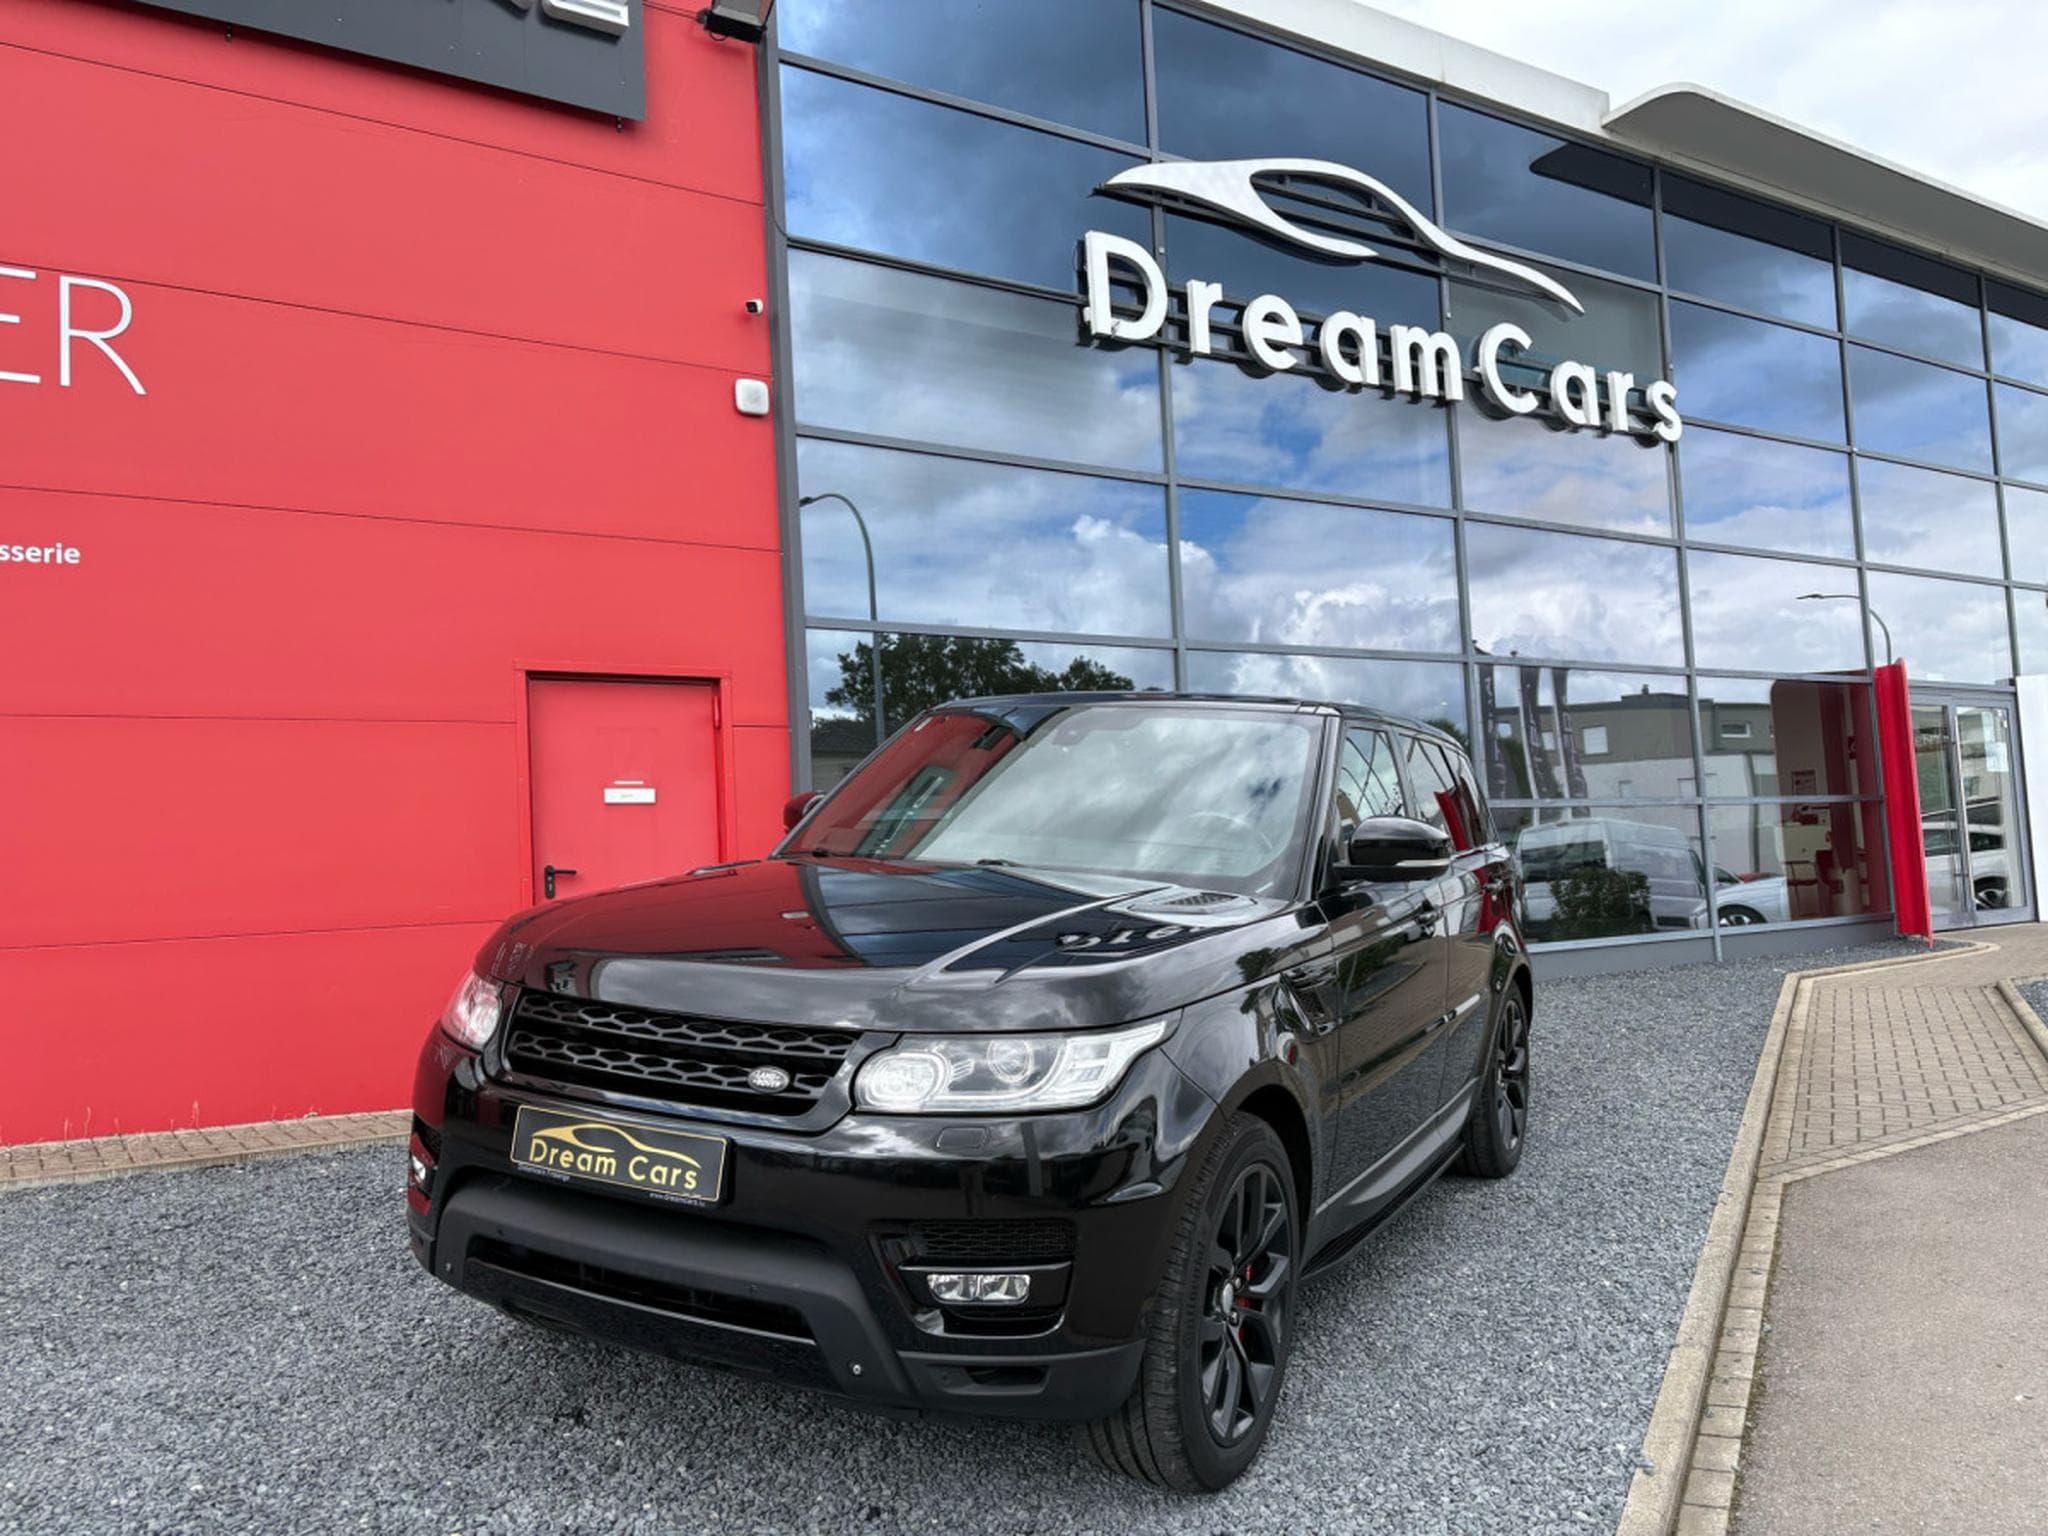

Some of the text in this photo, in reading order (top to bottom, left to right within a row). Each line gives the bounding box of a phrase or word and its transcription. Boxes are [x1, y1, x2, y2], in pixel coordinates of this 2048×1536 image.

[1084, 230, 1683, 442] Dream Cars
[0, 542, 81, 565] sserie
[529, 1138, 617, 1176] Dream
[628, 1155, 698, 1191] Cars
